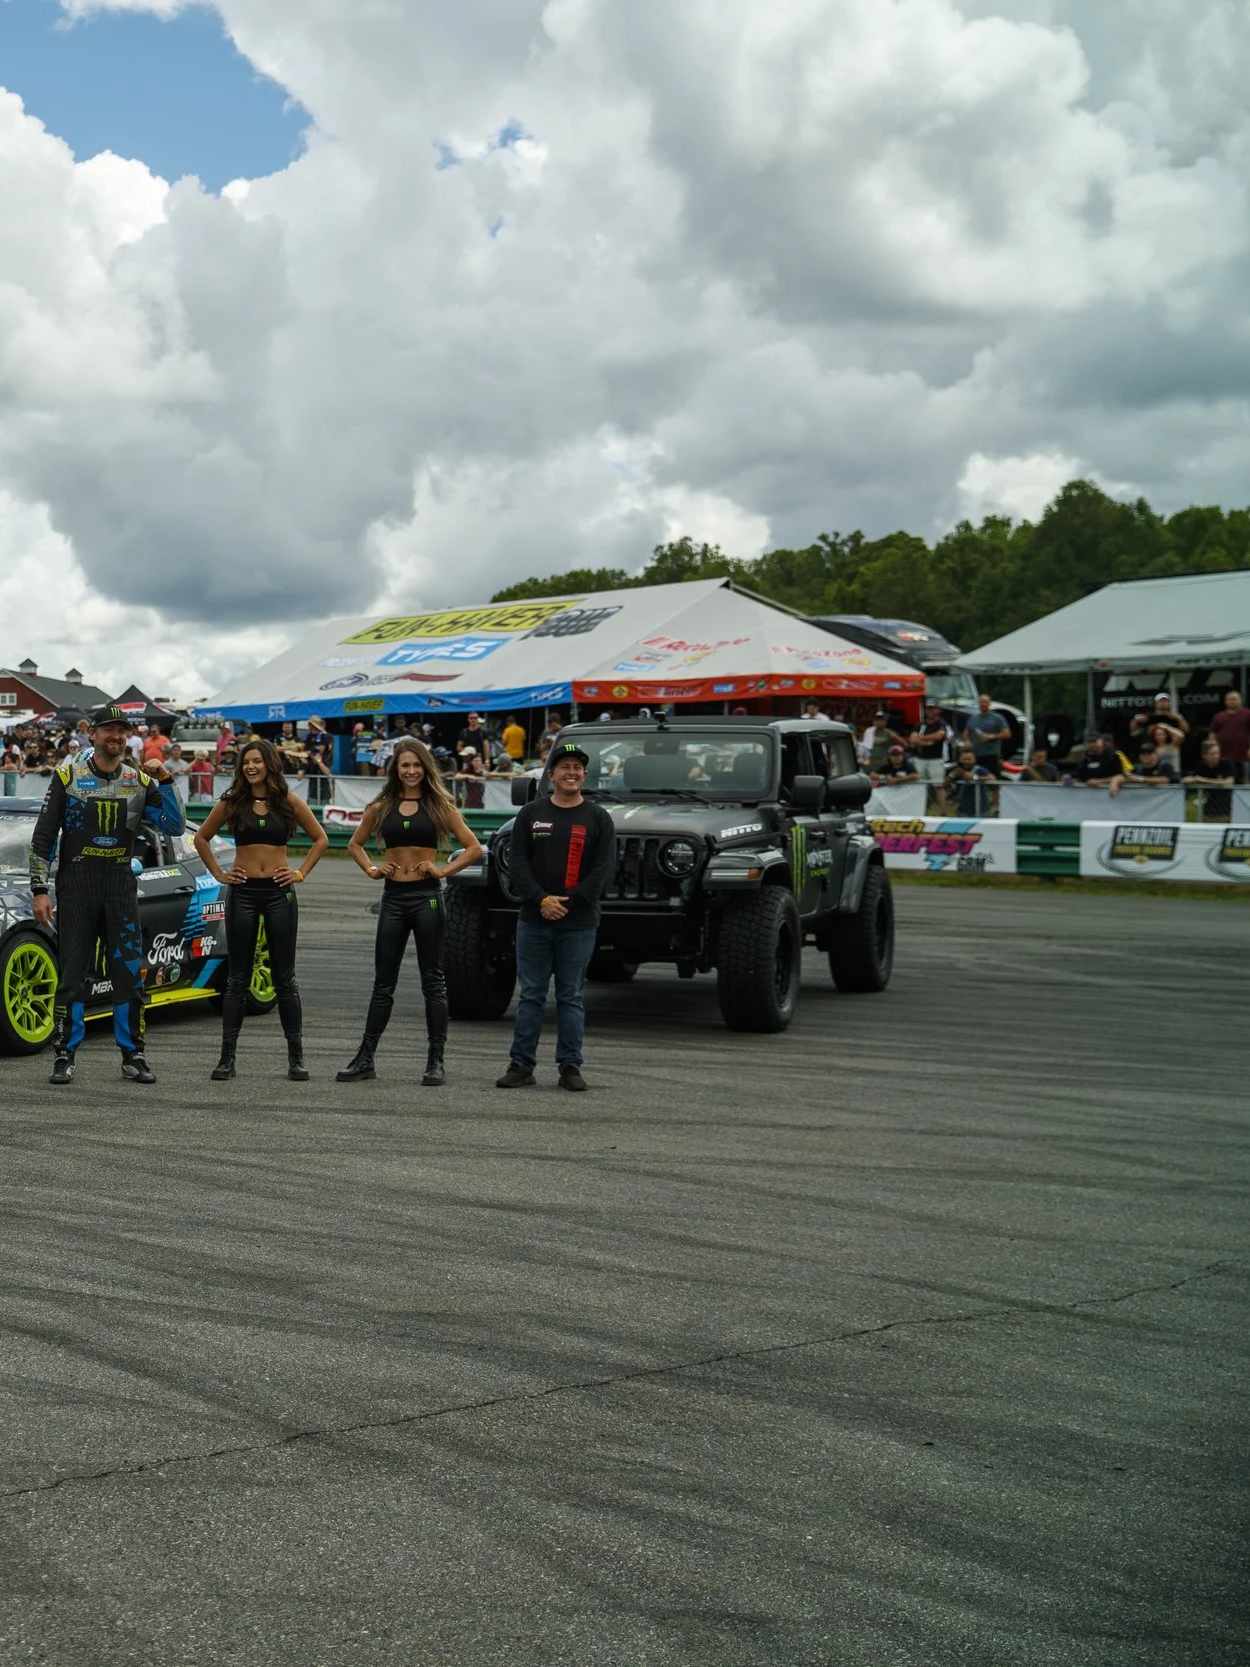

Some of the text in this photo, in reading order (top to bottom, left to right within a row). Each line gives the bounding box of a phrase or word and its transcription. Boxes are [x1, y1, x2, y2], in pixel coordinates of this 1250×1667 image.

[353, 605, 567, 640] FUN-HAVER
[720, 823, 763, 838] NITTO
[203, 903, 225, 914] OPTIMA
[147, 932, 185, 965] Ford
